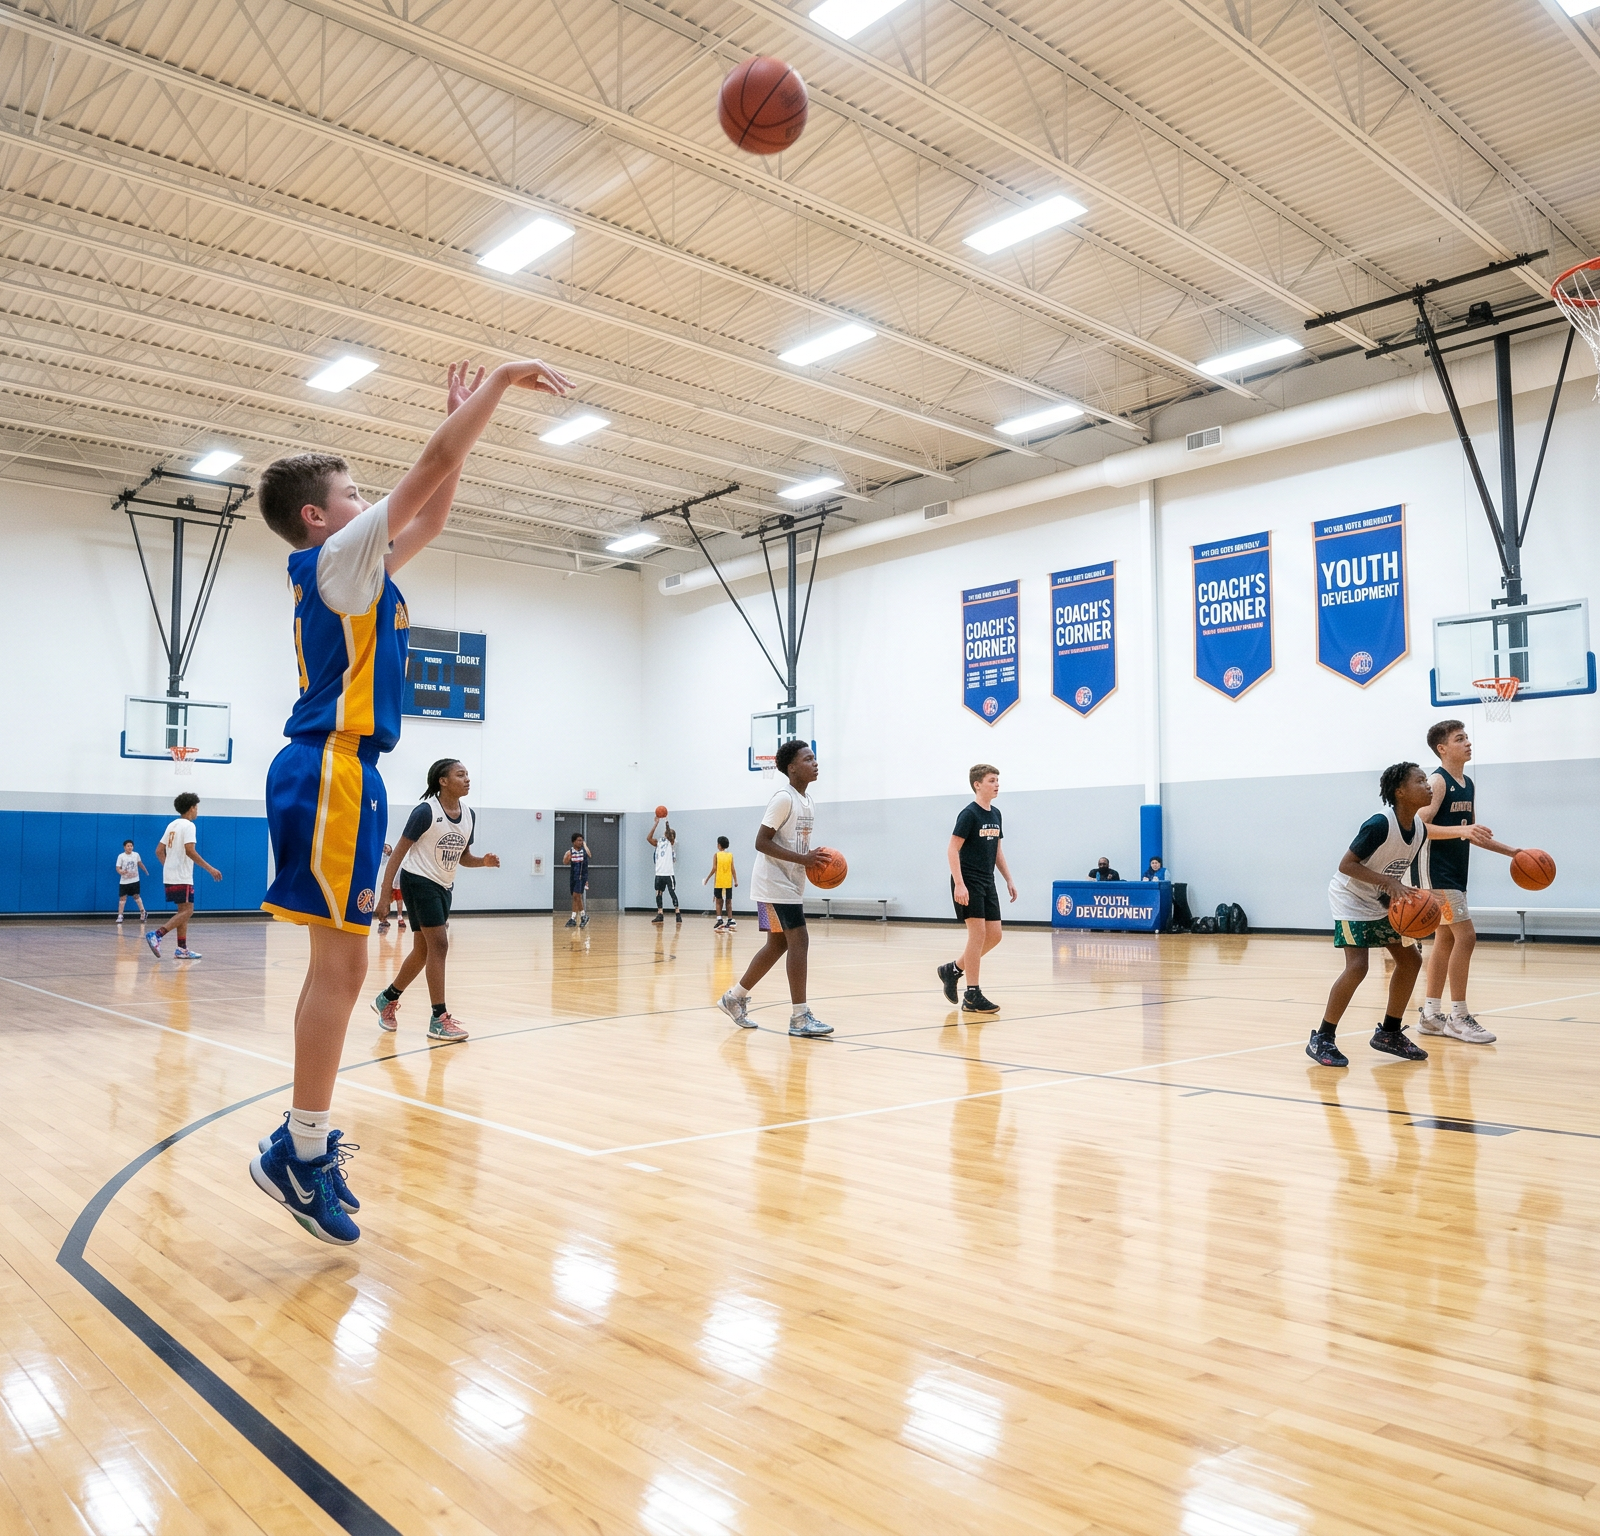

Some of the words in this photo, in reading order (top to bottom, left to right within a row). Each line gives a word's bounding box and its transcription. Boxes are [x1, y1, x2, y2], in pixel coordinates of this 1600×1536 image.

[1321, 551, 1399, 589] YOUTH
[1198, 572, 1266, 604] COACH'S
[1321, 582, 1399, 607] DEVELOPMENT
[1056, 598, 1111, 625] COACH'S
[1199, 597, 1266, 626] CORNER
[966, 616, 1015, 640] COACH'S
[1056, 620, 1111, 646] CORNER
[966, 636, 1016, 660] CORNER
[1076, 906, 1153, 919] DEVELOPMENT
[1093, 895, 1129, 906] YOUTH
